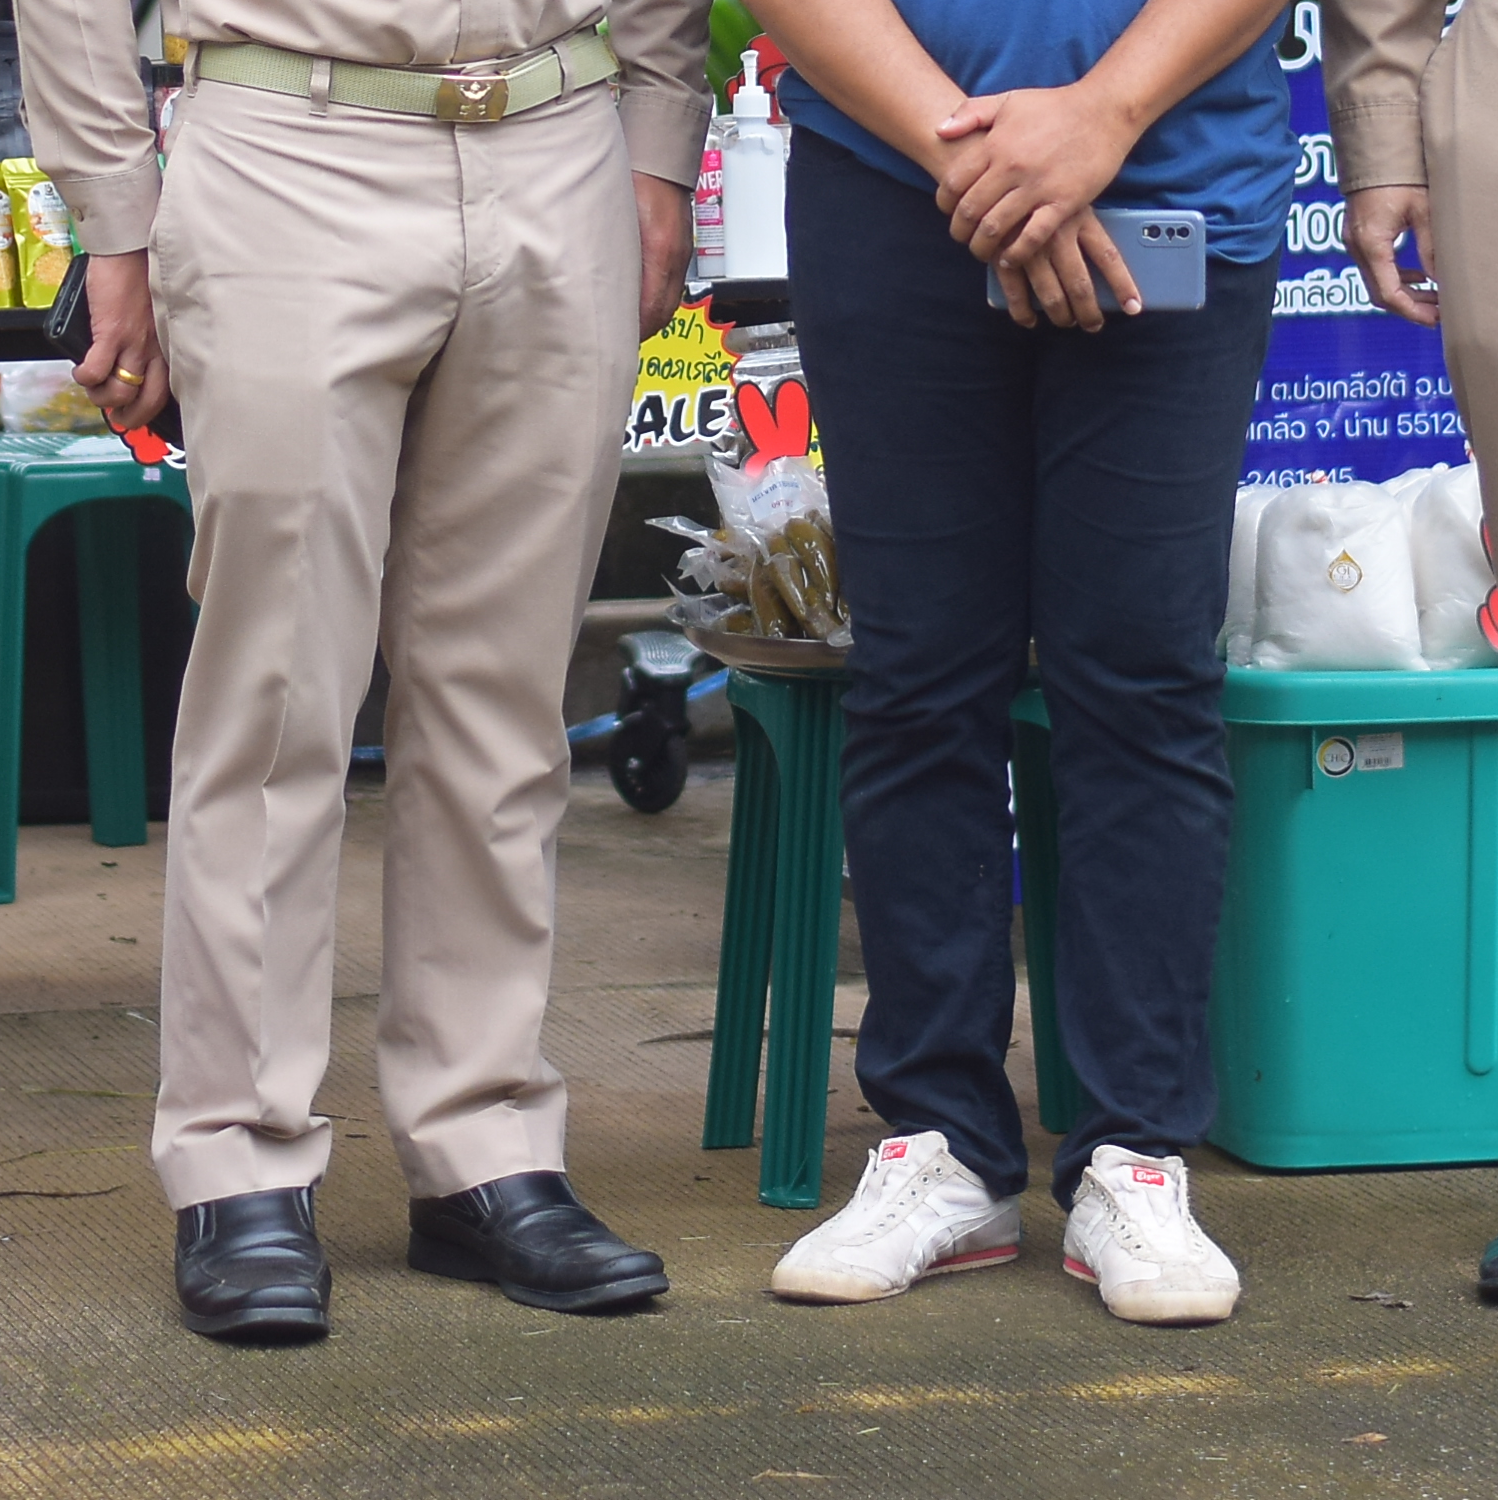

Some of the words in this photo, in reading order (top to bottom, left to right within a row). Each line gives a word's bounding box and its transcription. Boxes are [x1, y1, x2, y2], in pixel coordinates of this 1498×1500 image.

[1271, 371, 1407, 400] ต.บ่อเกลือใต้
[623, 386, 731, 450] ALE
[1246, 412, 1306, 440] เกลือ
[1315, 419, 1337, 438] จ.
[1344, 412, 1388, 437] น่าน
